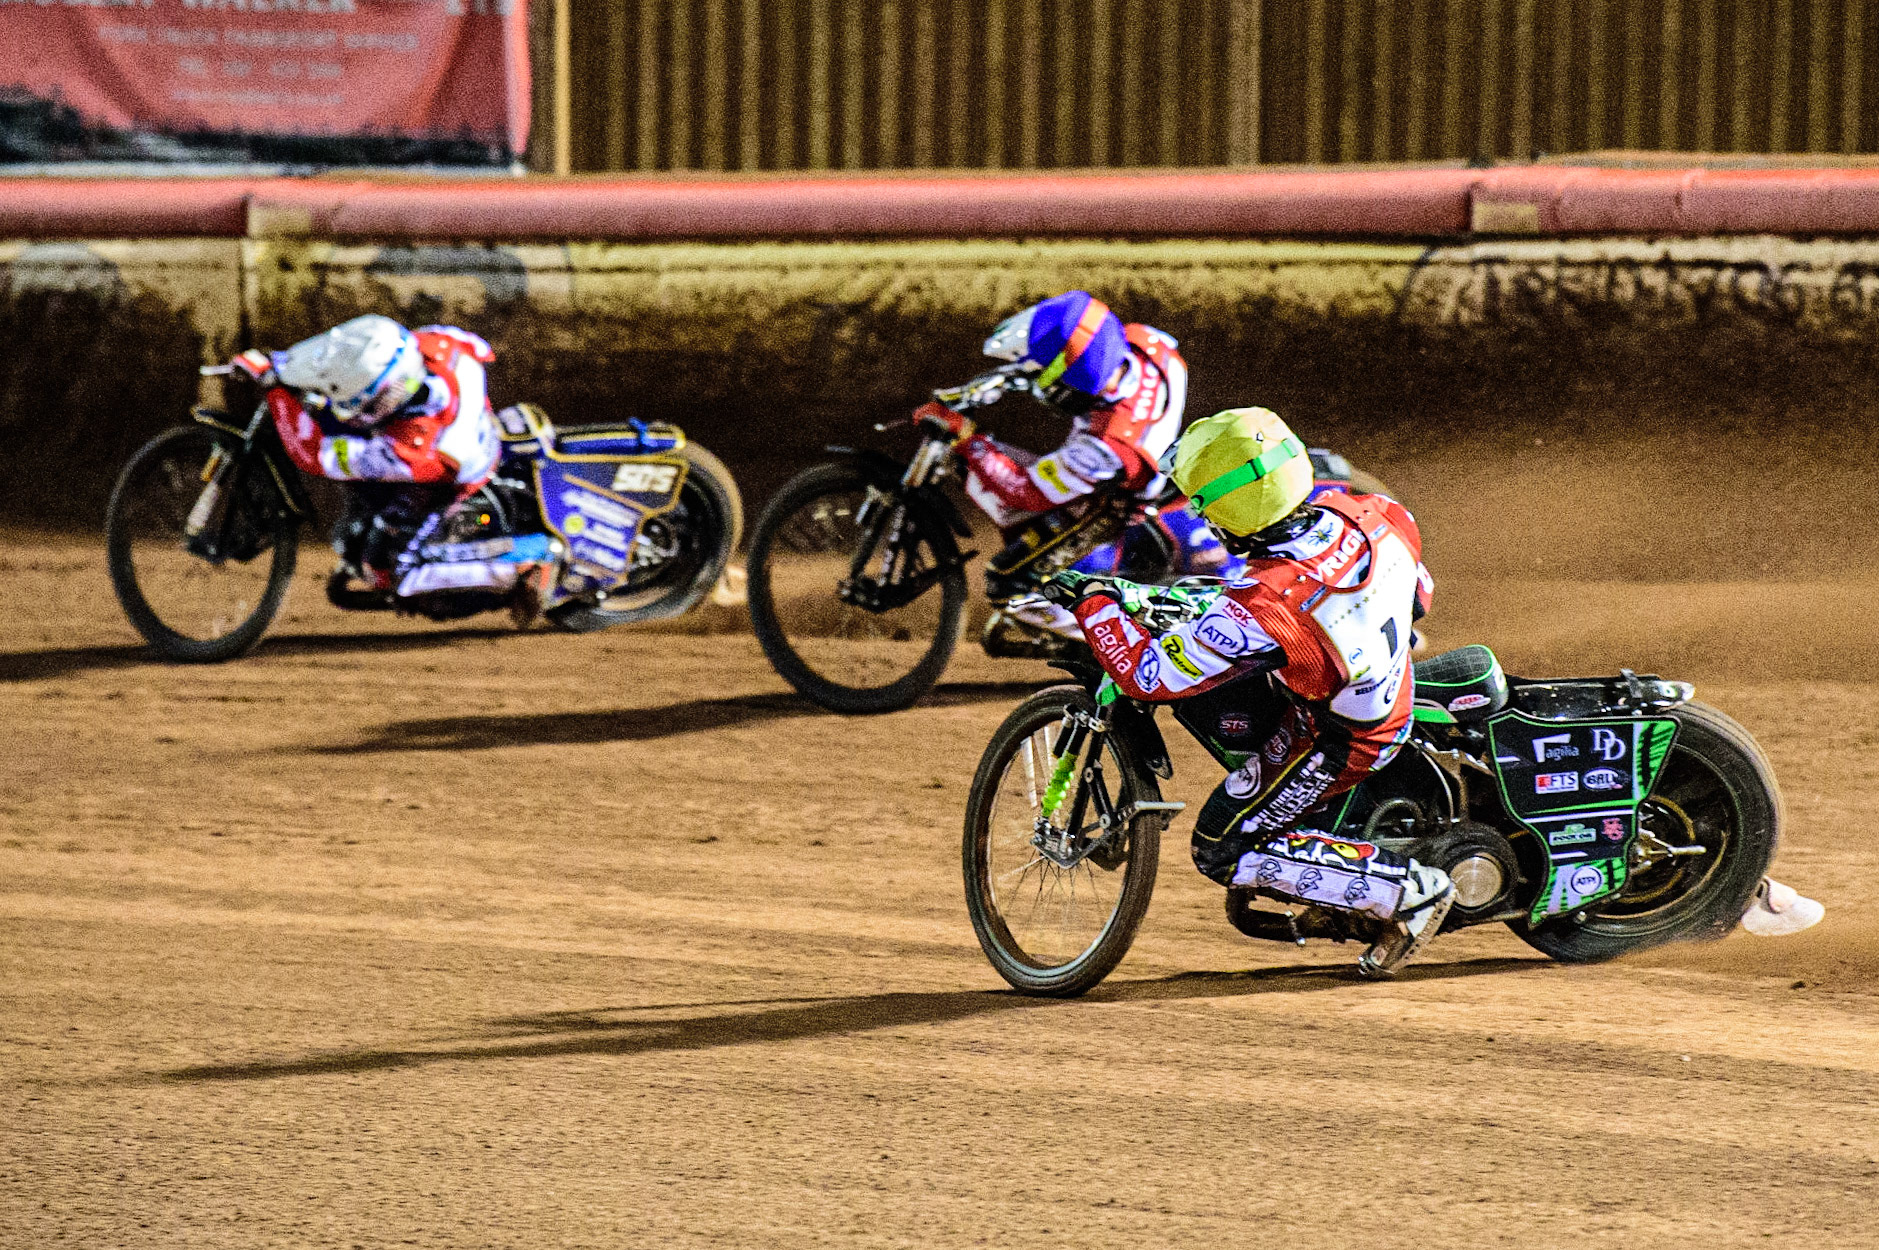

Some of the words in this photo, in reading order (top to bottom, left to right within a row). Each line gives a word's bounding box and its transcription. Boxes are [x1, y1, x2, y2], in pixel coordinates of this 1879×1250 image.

[1225, 600, 1255, 625] NGK
[1202, 625, 1238, 649] ATPI
[1093, 624, 1133, 675] agilia
[1219, 719, 1249, 730] STS
